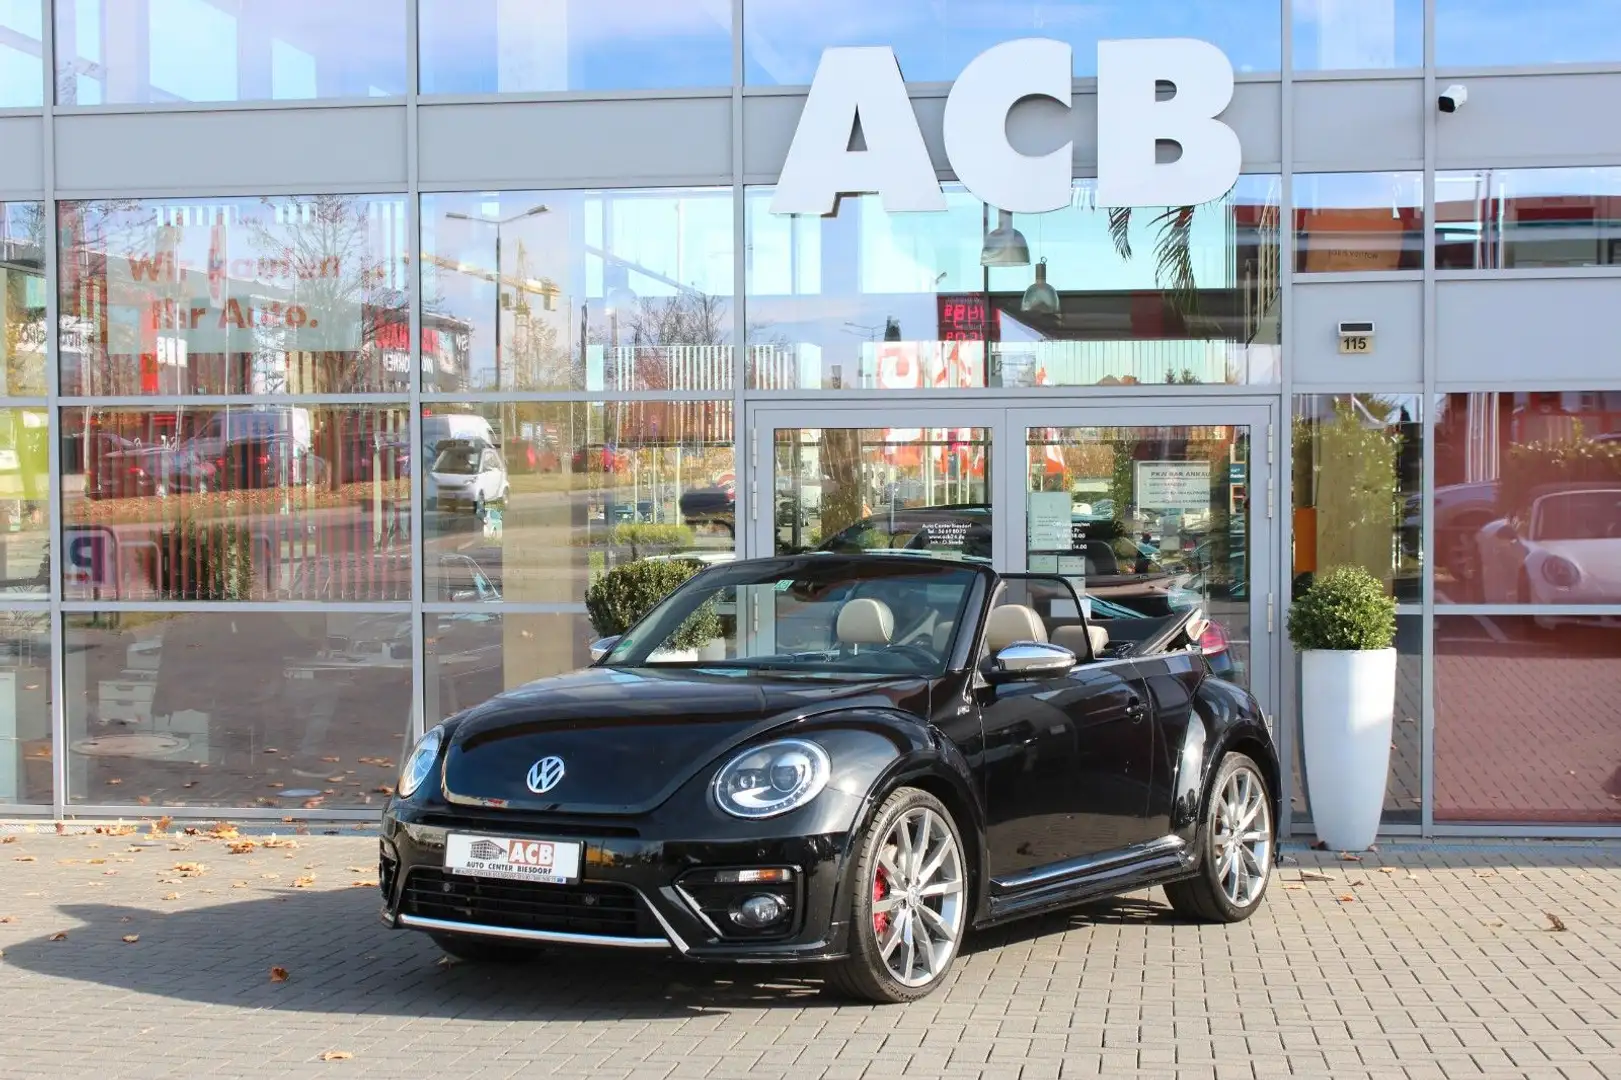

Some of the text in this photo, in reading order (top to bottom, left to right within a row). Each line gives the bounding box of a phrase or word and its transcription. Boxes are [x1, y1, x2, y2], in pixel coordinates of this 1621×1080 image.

[769, 37, 1242, 214] ACB
[1343, 336, 1367, 350] 115
[509, 843, 554, 866] ACB
[466, 861, 553, 875] AUTO CENTER BIESDORF
